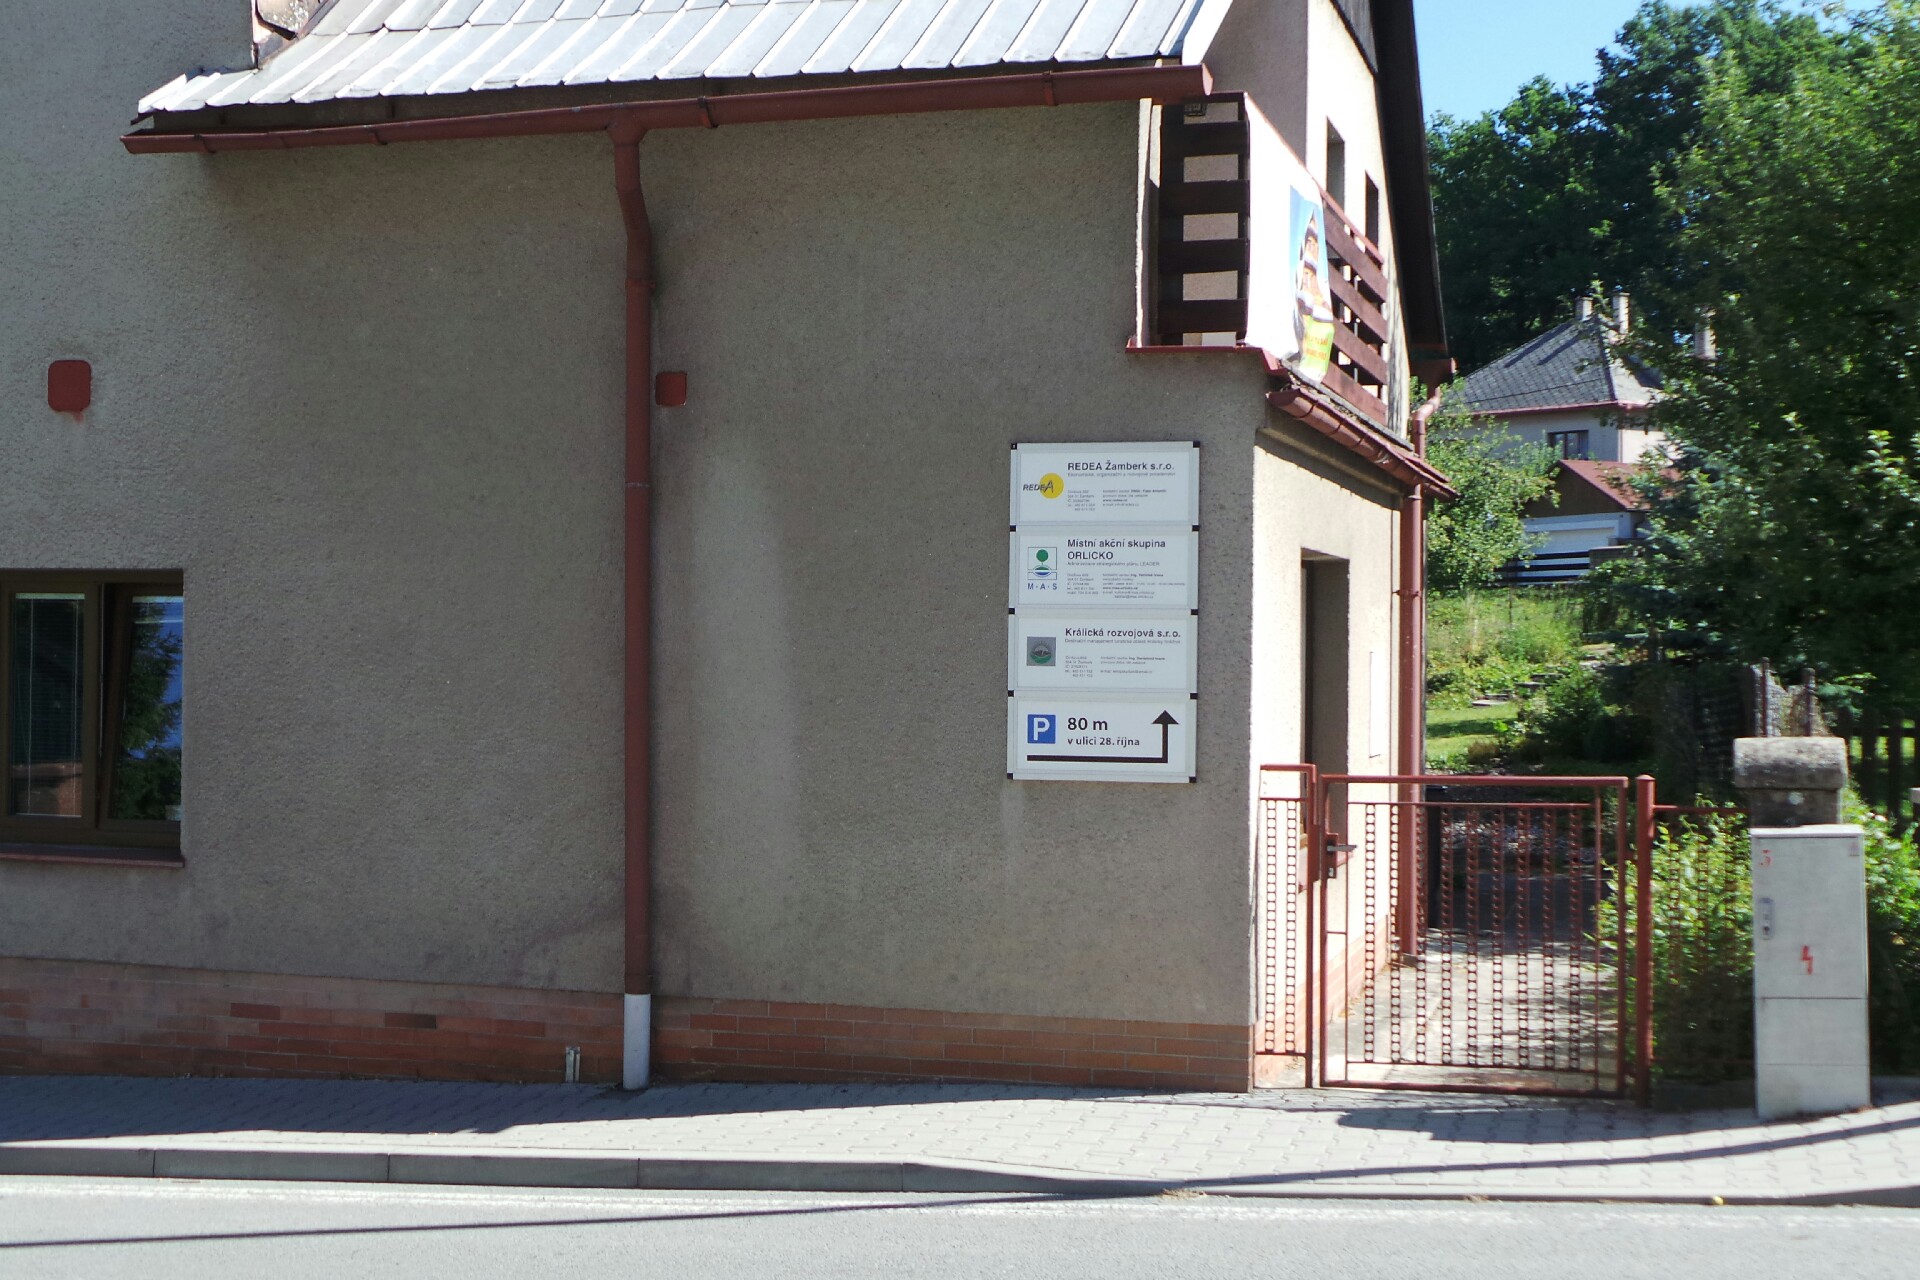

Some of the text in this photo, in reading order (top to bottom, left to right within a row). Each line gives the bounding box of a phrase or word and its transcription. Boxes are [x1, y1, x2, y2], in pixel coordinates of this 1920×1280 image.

[1067, 460, 1175, 471] REDEA Žamberk s.r.o.
[1023, 480, 1054, 493] REDEA
[1067, 538, 1166, 550] Místní akční skupina
[1067, 551, 1114, 560] ORLICKO
[1027, 583, 1034, 591] M
[1040, 583, 1046, 591] A
[1052, 583, 1058, 591] S
[1065, 627, 1181, 639] Králická rozvojová s.r.o.
[1033, 717, 1050, 741] P
[1067, 717, 1109, 731] 80 m
[1075, 736, 1097, 746] ulici
[1099, 737, 1115, 746] 28.
[1116, 736, 1140, 749] října
